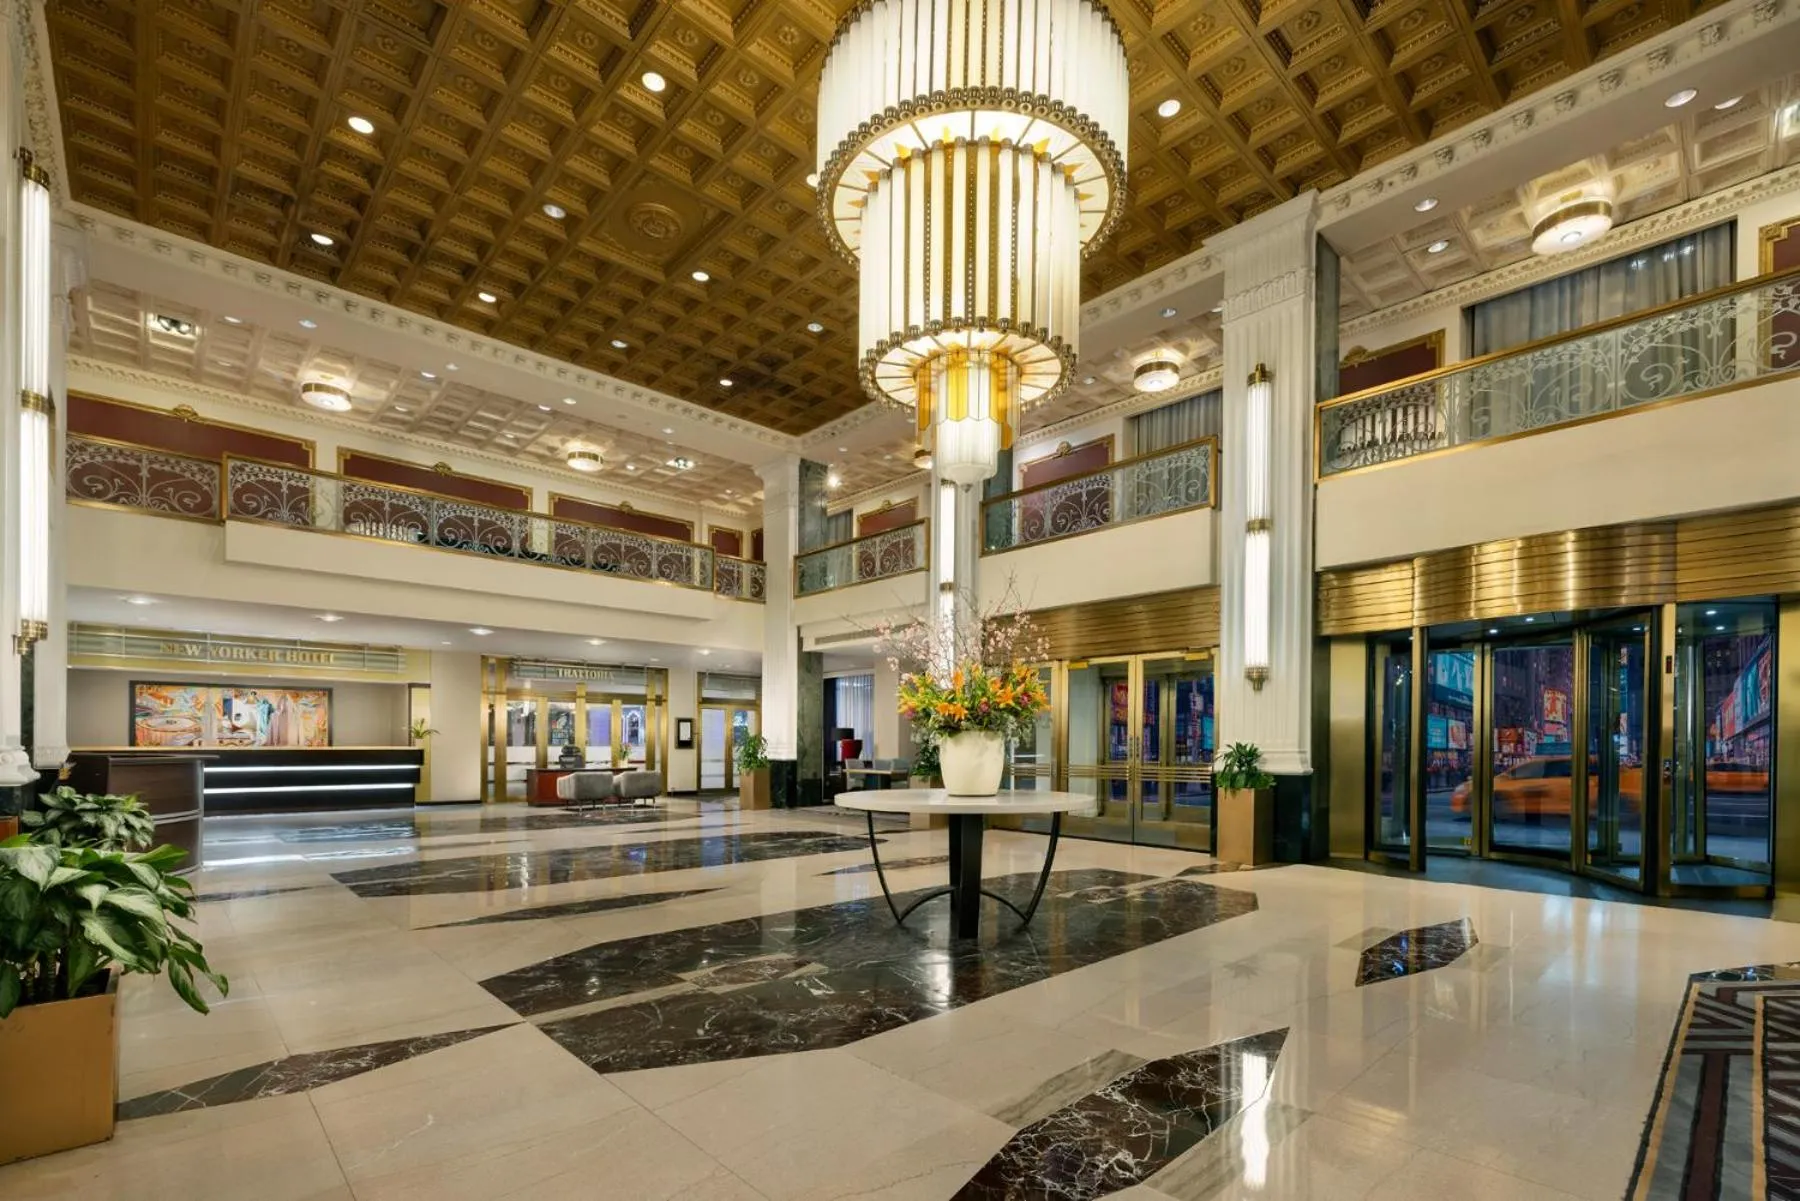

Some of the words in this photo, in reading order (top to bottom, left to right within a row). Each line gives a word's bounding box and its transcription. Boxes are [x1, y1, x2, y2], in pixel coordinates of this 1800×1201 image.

[160, 642, 201, 656] NEW
[209, 645, 280, 663] YORKER
[286, 650, 335, 664] HOTEL
